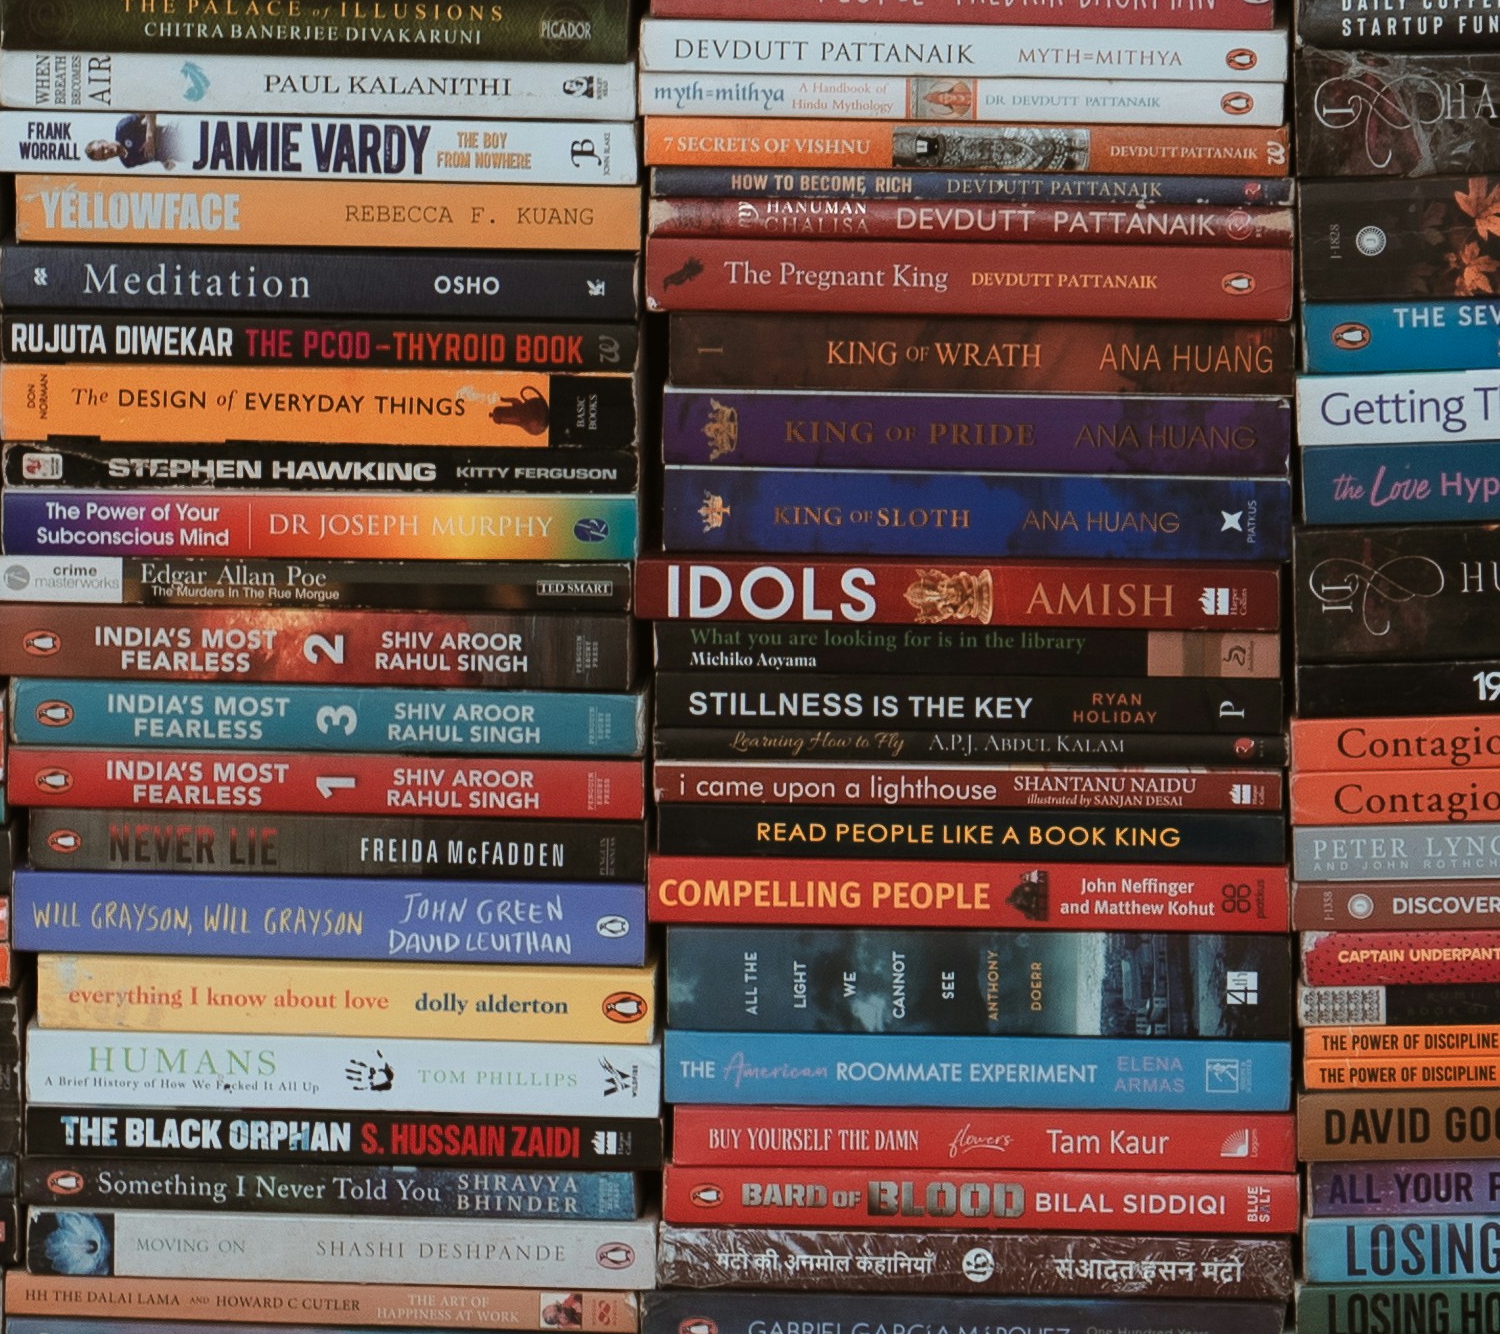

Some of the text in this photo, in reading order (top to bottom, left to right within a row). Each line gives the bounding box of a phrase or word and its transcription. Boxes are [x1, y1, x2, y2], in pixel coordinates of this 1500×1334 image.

[40, 189, 240, 232] YELLOWFACE
[1320, 389, 1462, 434] Getting
[666, 566, 876, 618] IDOLS
[1047, 1128, 1169, 1156] Tam Kaur
